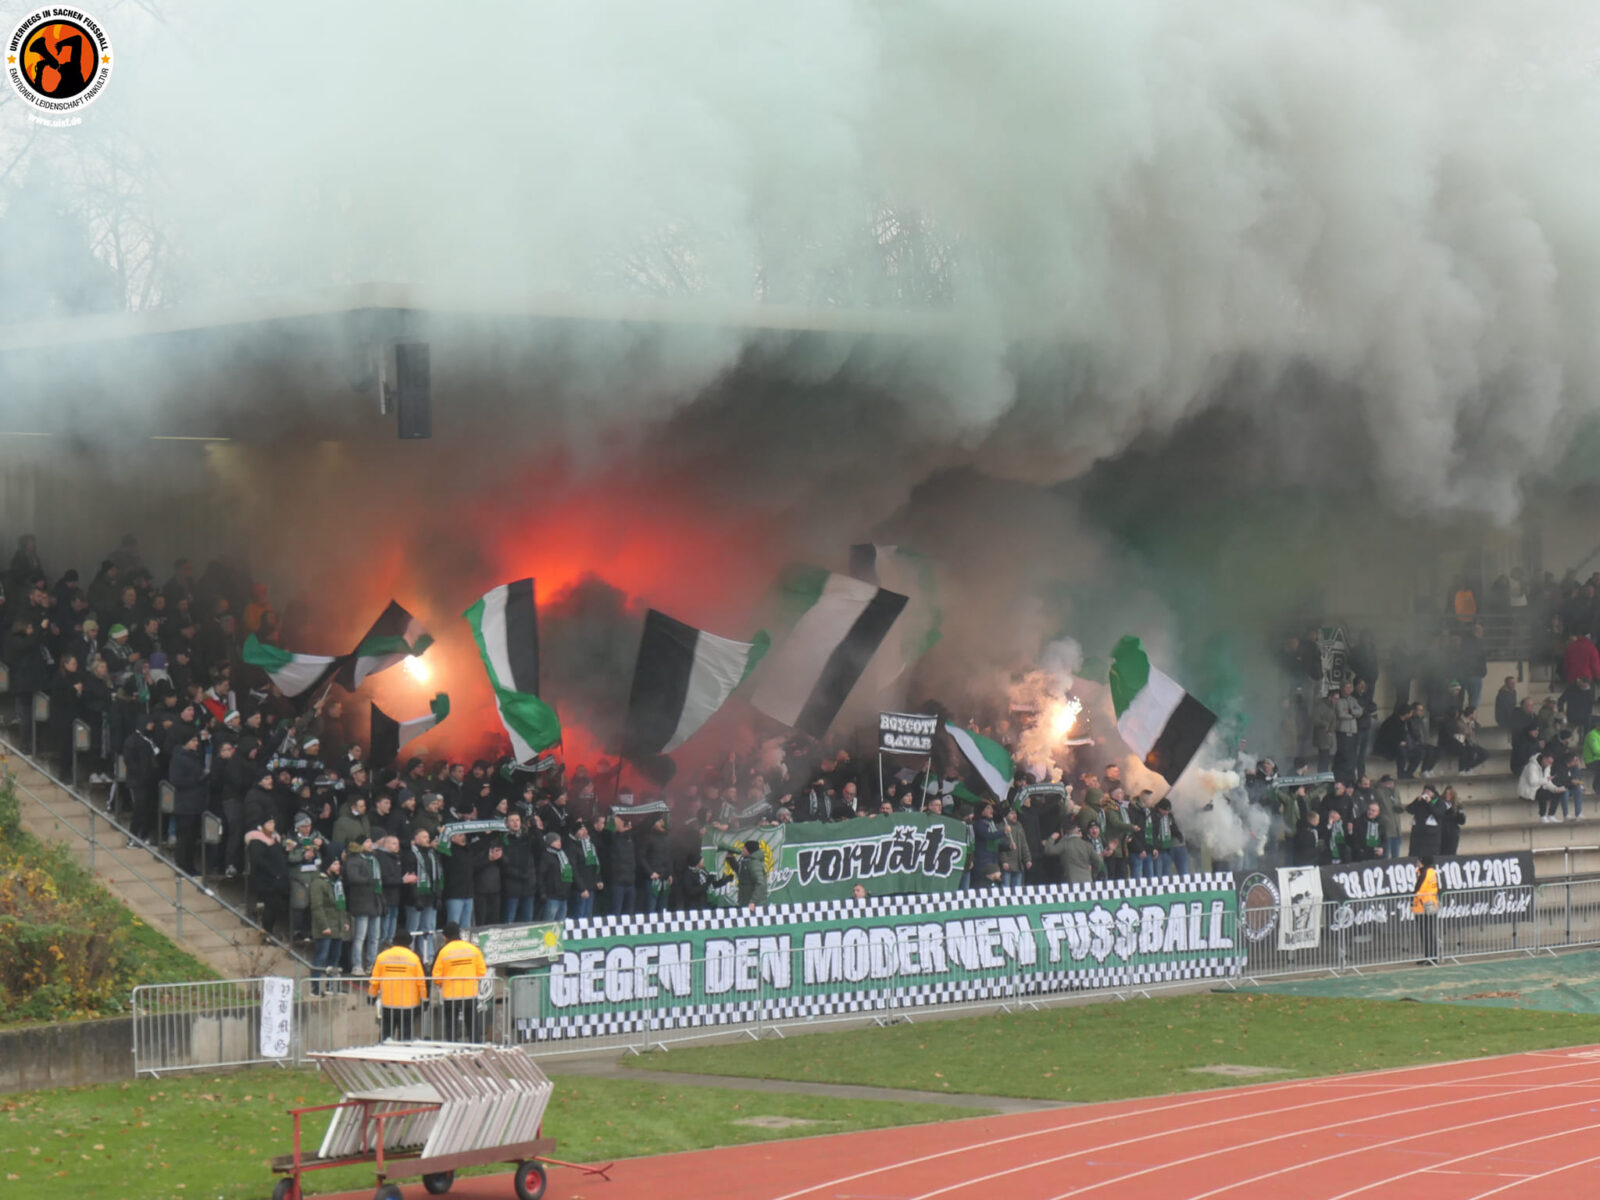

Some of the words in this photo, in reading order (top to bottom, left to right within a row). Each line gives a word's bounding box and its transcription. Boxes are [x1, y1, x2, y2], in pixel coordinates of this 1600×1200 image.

[884, 733, 931, 750] QATAR
[549, 941, 691, 1008] GEGEN
[705, 933, 792, 996] DEN
[803, 914, 1038, 985] MODERNEN
